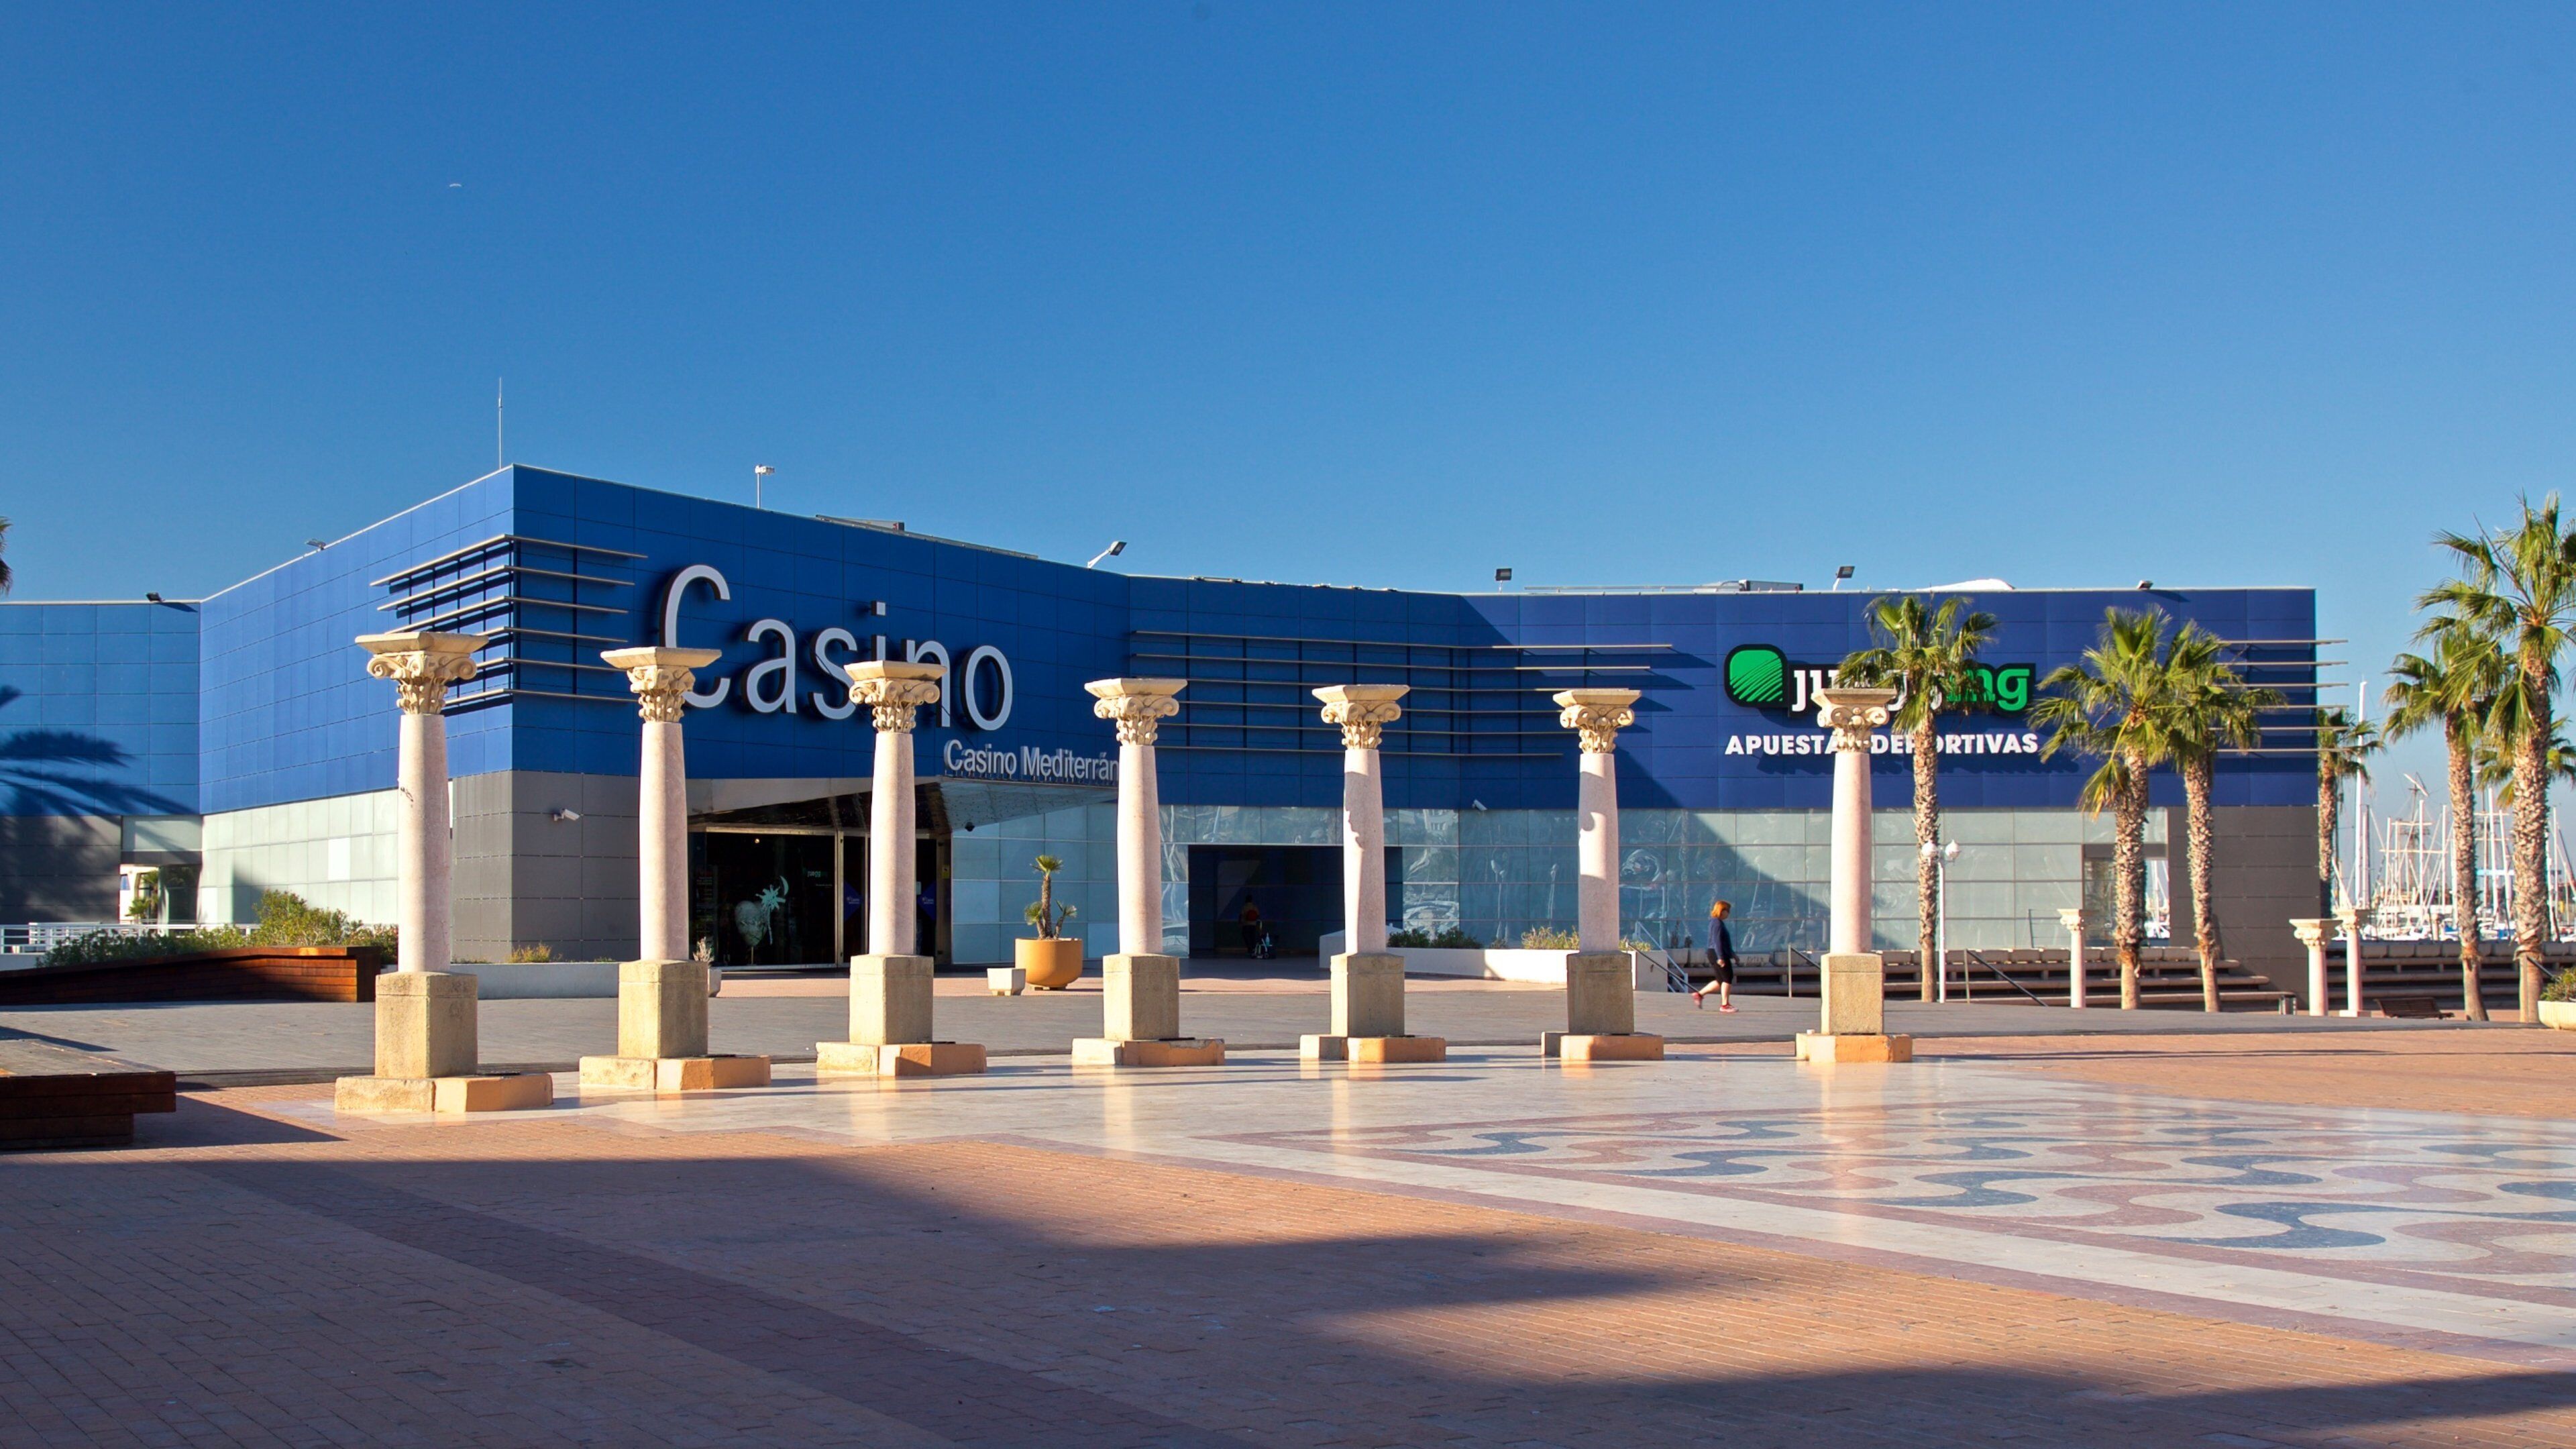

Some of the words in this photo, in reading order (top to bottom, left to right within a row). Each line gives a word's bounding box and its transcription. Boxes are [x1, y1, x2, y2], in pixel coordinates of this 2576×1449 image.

[944, 739, 1017, 775] Casino
[1020, 745, 1119, 781] Mediterrán
[1725, 735, 1841, 755] APUESTA
